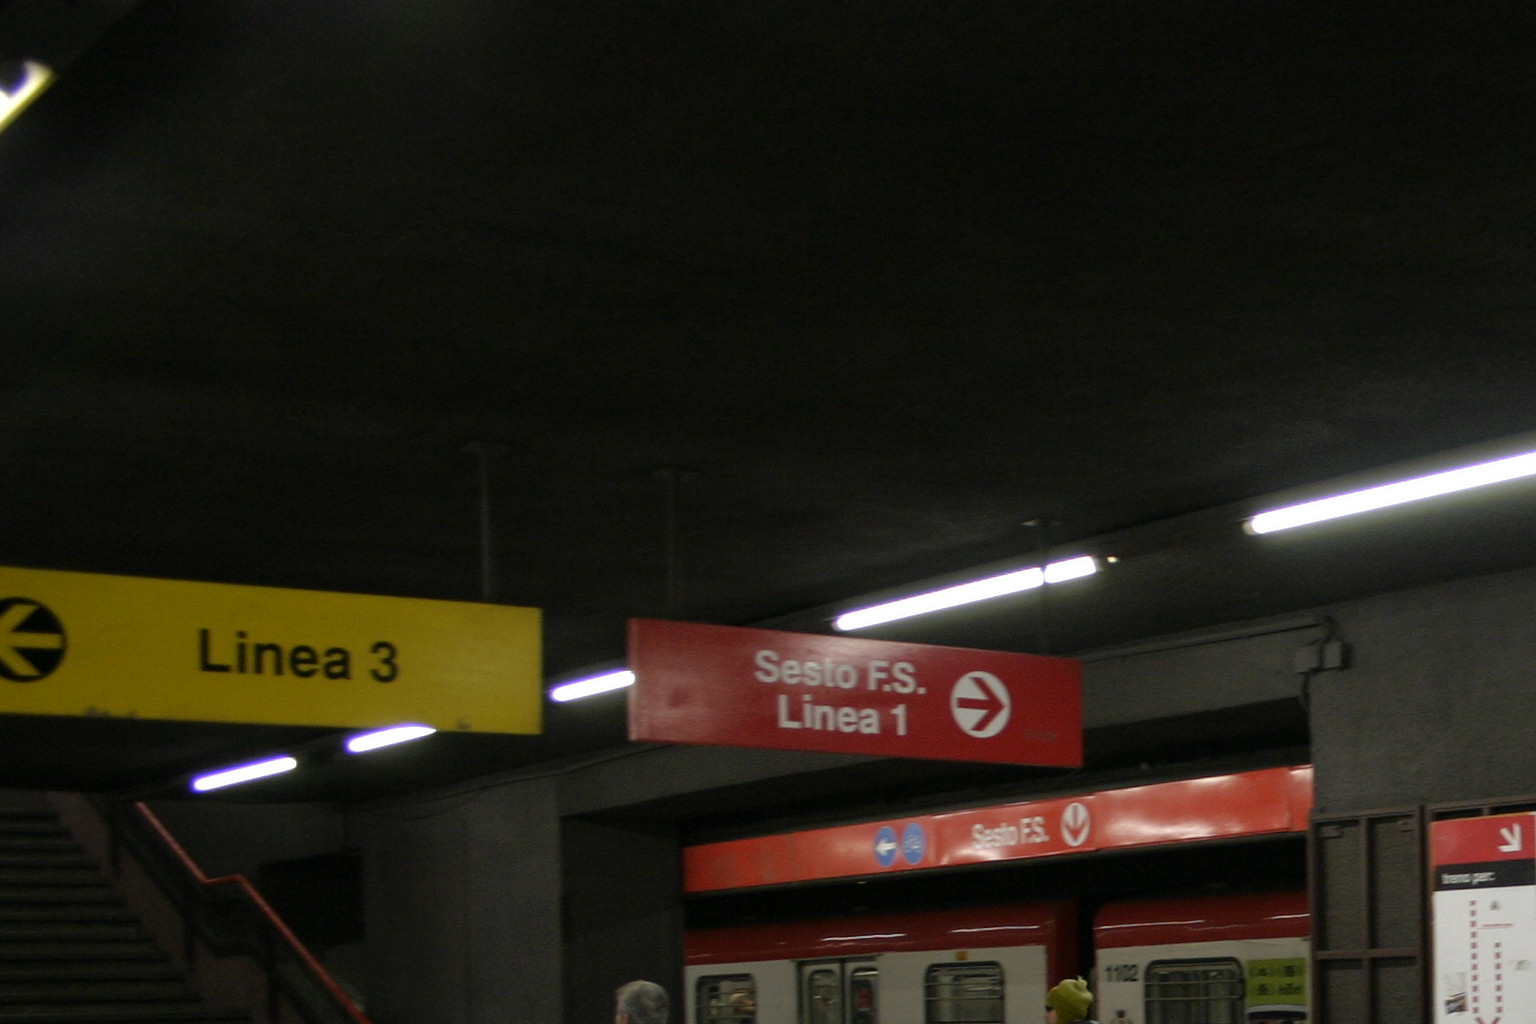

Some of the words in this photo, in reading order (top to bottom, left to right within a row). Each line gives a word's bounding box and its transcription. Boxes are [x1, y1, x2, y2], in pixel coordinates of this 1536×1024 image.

[199, 628, 351, 680] Linea
[371, 640, 399, 683] 3
[754, 649, 859, 690] Sesto
[867, 660, 928, 695] F.S.
[777, 693, 881, 735] Linea
[890, 703, 908, 737] 1
[970, 822, 1018, 850] Sesto
[1105, 963, 1139, 983] 1102
